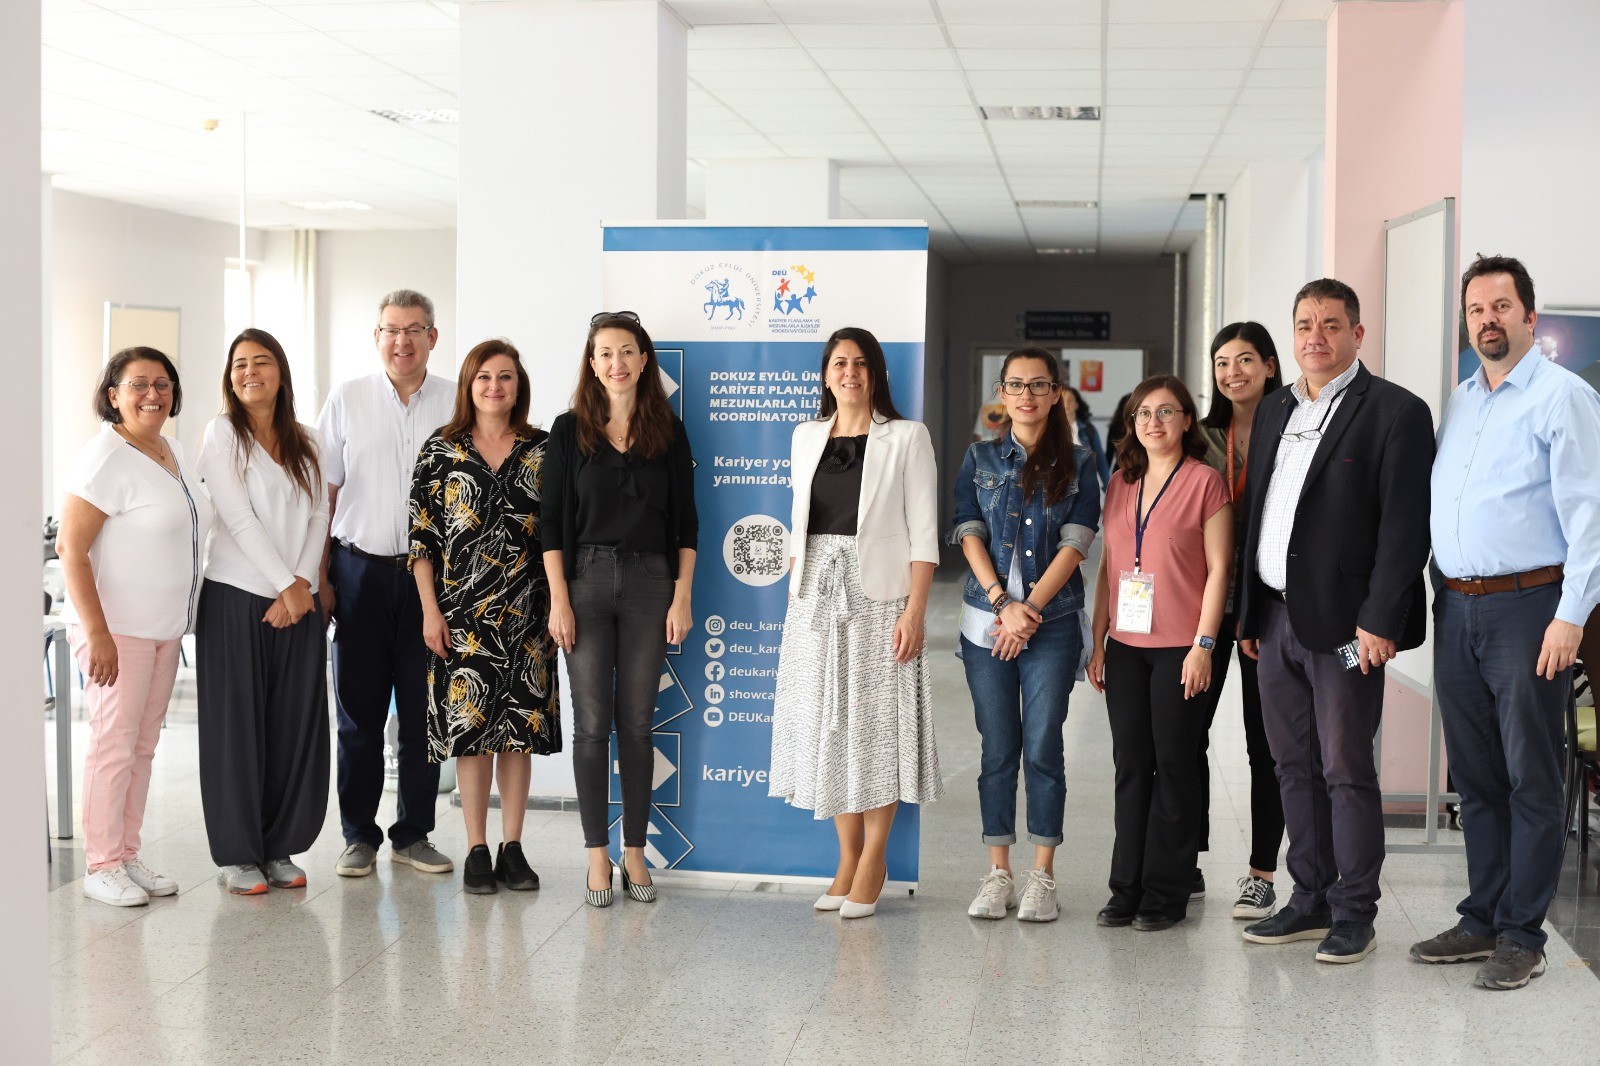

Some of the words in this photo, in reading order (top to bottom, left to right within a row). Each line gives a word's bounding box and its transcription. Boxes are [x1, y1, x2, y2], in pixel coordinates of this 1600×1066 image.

[710, 371, 755, 381] DOKUZ
[759, 370, 798, 381] EYLÜL
[710, 383, 765, 395] KARİYER
[710, 398, 797, 409] MEZUNLARLA
[714, 456, 768, 470] Kariyer
